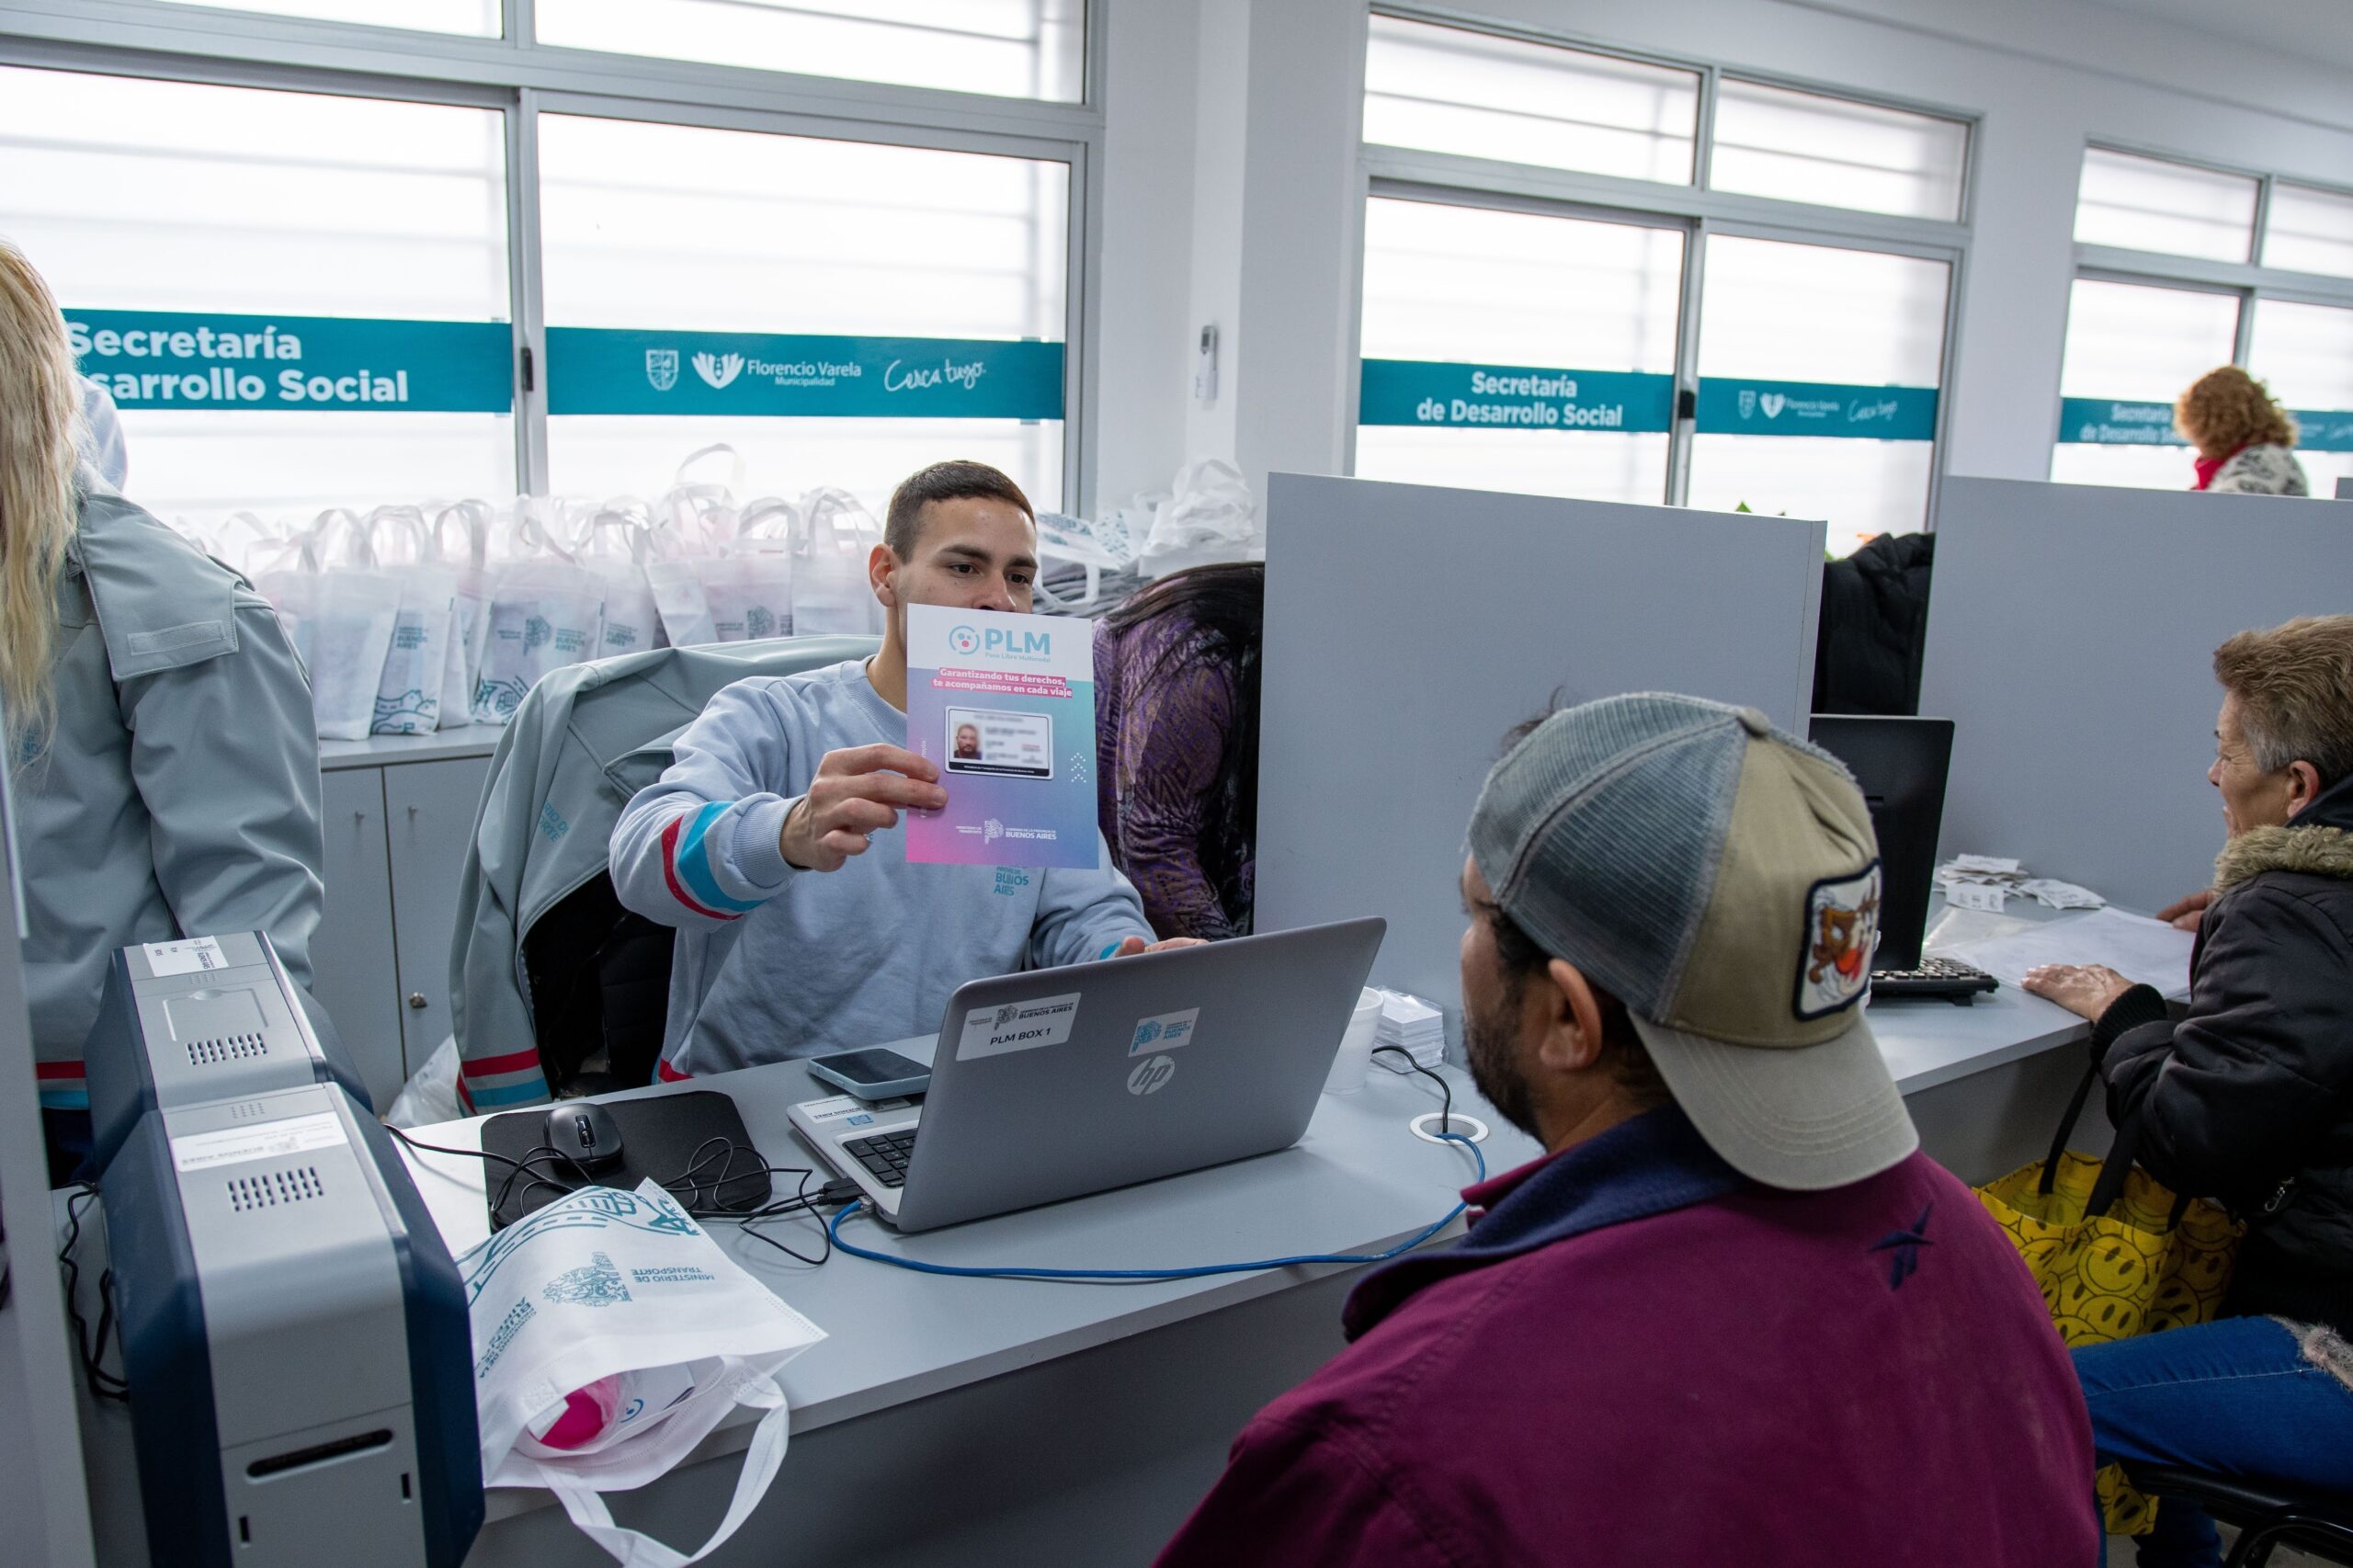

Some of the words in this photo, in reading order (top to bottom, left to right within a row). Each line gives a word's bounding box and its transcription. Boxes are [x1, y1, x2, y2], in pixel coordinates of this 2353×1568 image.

[67, 323, 302, 359] Secretaría
[747, 359, 816, 377] Florencio
[817, 361, 862, 378] Varela
[89, 367, 266, 401] sarrollo
[278, 369, 408, 402] Social
[775, 376, 835, 388] Municipalidad
[1471, 370, 1577, 397] Secretaría
[1416, 397, 1446, 422] de
[1449, 399, 1559, 425] Desarrollo
[1563, 403, 1623, 426] Social
[984, 628, 1051, 655] PLM
[939, 667, 1003, 681] Garantizando
[1005, 674, 1019, 682] tus
[1021, 674, 1066, 687] derechos,
[933, 678, 943, 687] te
[945, 681, 1012, 692] acompañamos
[1013, 685, 1026, 693] en
[1027, 687, 1049, 695] cada
[1050, 687, 1073, 699] viaje
[1006, 831, 1035, 839] BUENOS
[1036, 832, 1057, 840] AIRES
[1018, 1009, 1050, 1020] BUENOS
[1051, 1006, 1074, 1015] AIRES
[990, 1033, 1017, 1046] PLM
[1017, 1028, 1043, 1040] BOX
[1046, 1028, 1051, 1036] 1
[1130, 1056, 1173, 1095] hp
[631, 1267, 703, 1276] TRANSPORTE
[633, 1275, 651, 1283] DE
[652, 1274, 715, 1283] MINISTERIO
[498, 1310, 538, 1354] GOBIERNO
